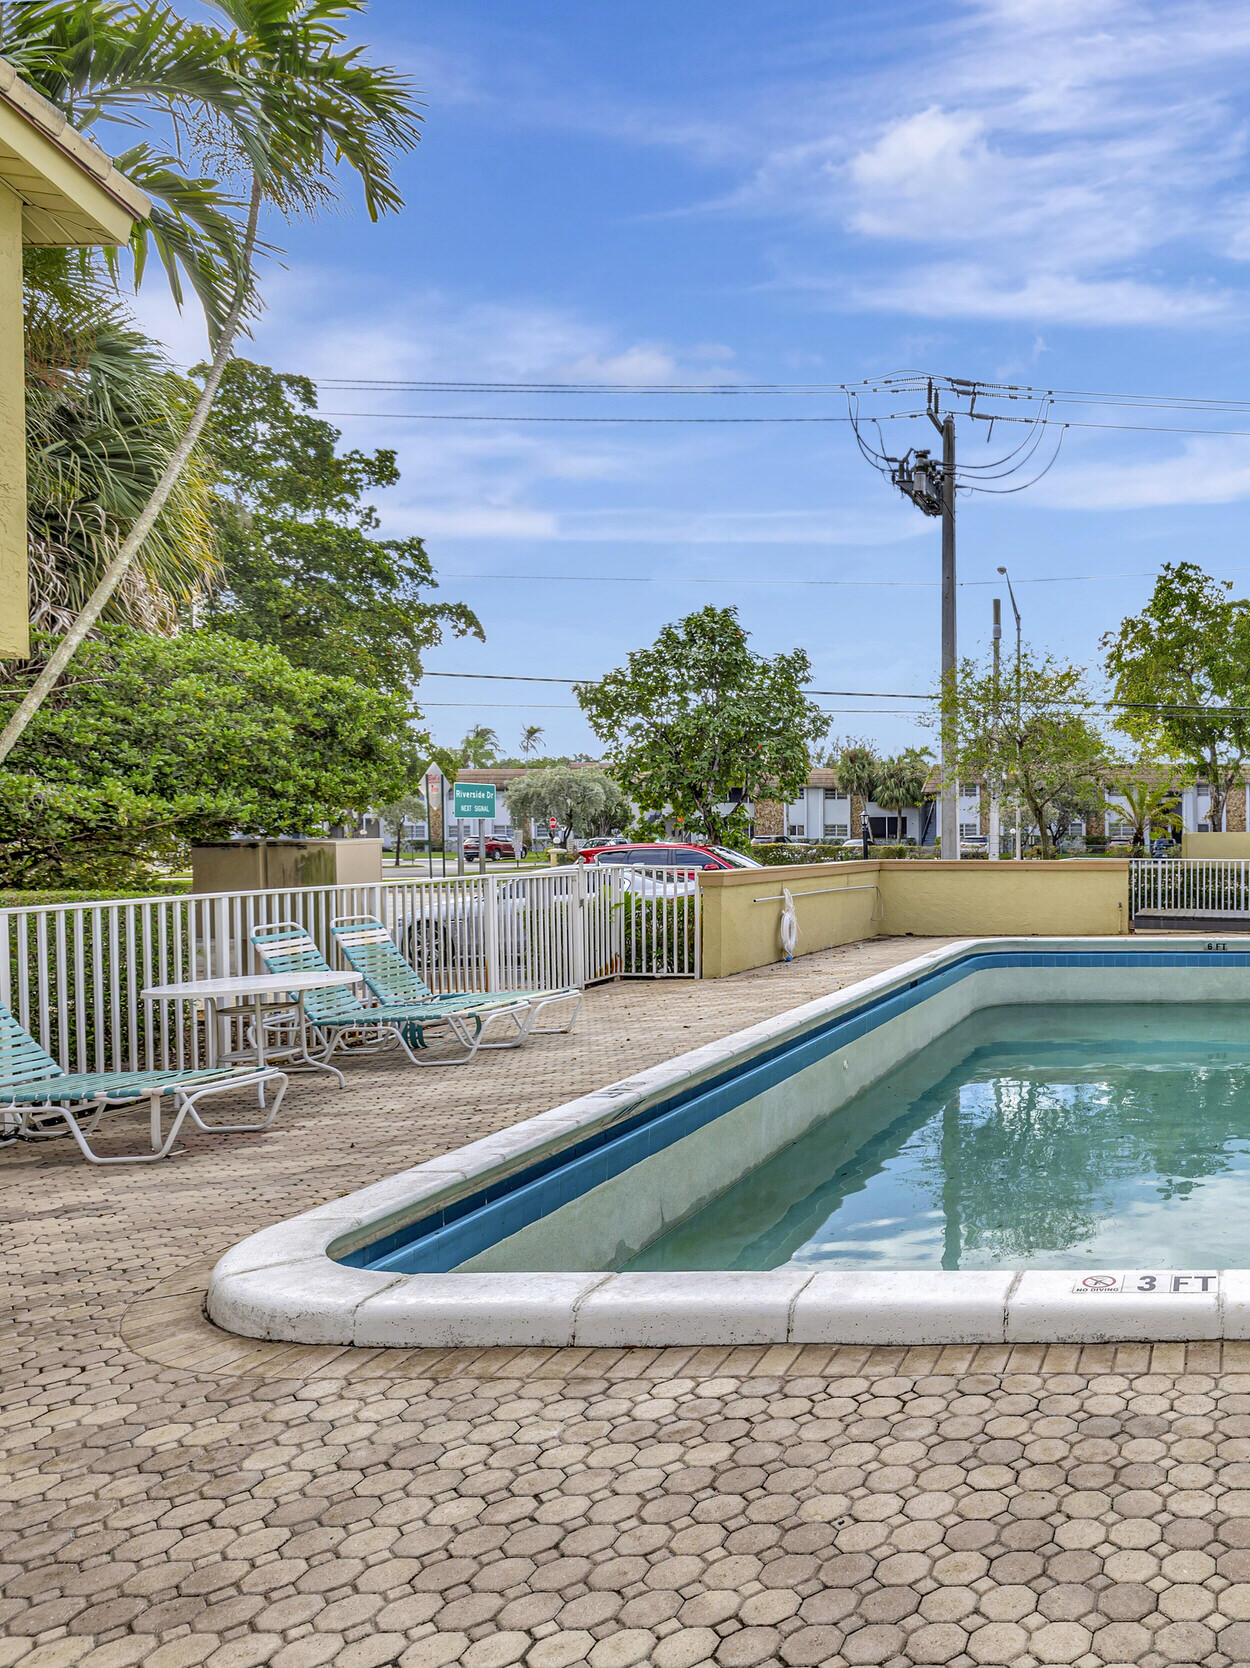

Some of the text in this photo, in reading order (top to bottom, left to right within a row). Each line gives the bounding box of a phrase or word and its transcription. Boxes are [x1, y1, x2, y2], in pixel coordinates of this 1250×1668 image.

[455, 790, 494, 799] Riverside Dr
[1136, 1275, 1157, 1292] 3
[1172, 1275, 1217, 1292] FT
